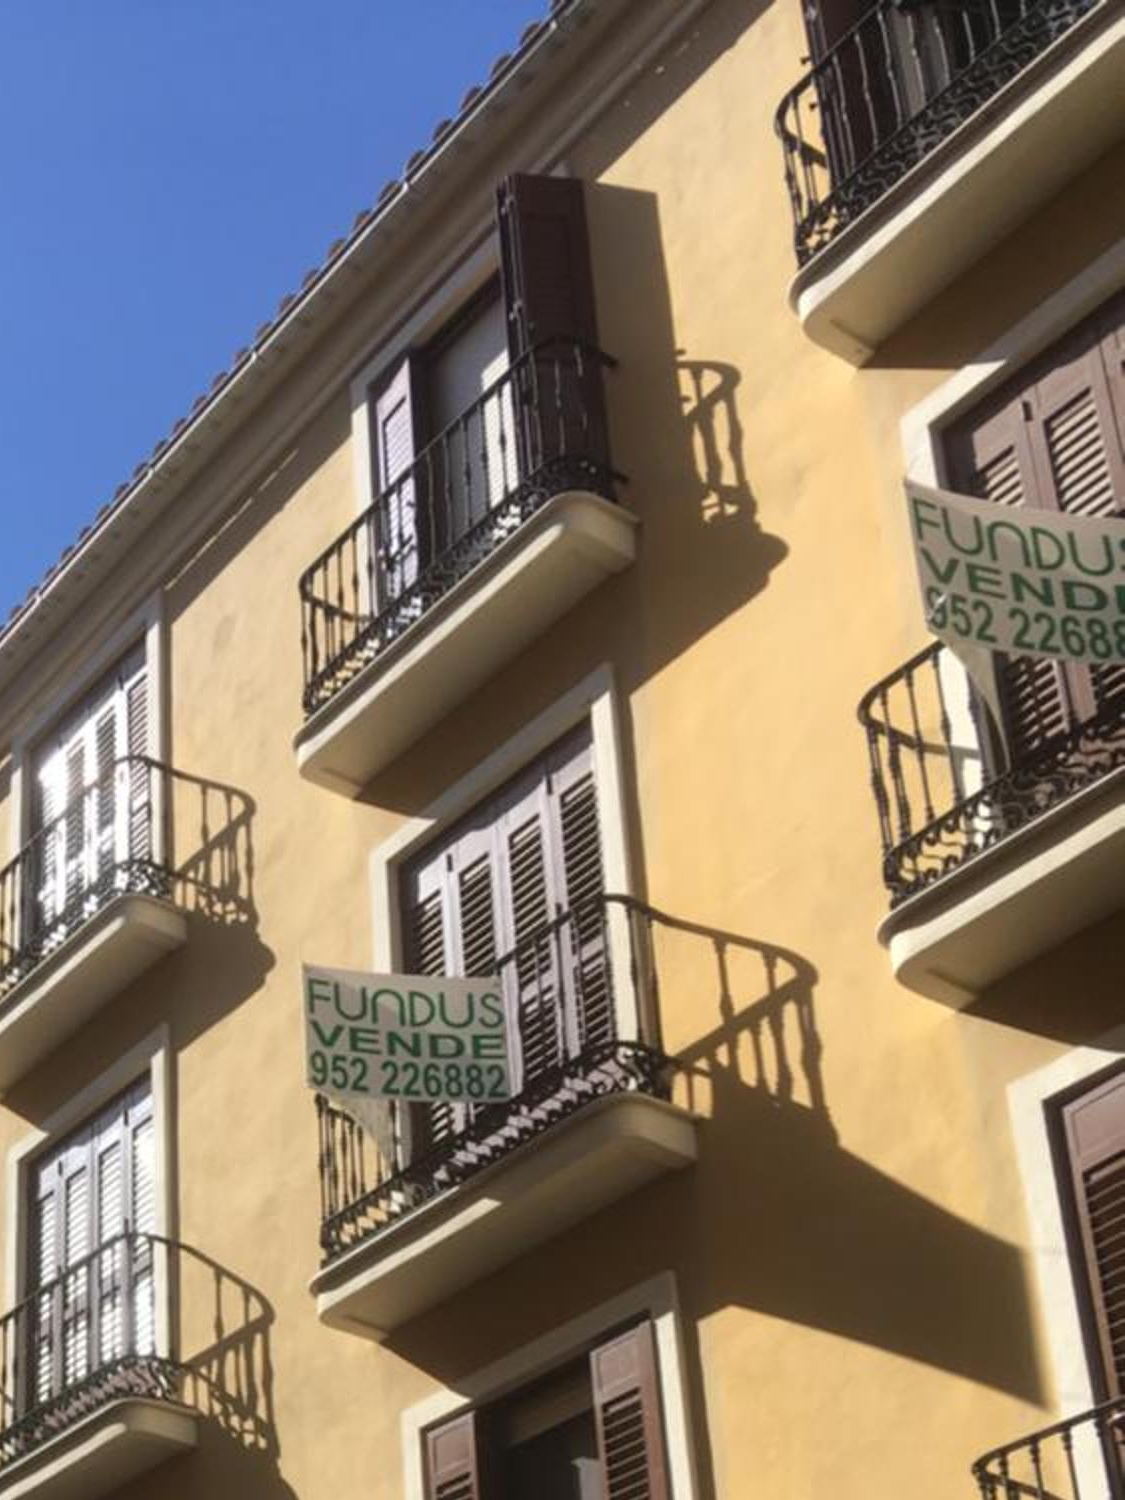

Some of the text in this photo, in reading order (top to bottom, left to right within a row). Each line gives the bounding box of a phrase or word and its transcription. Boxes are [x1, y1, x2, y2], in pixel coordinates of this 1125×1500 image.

[912, 498, 1125, 576] FUNDU
[926, 585, 998, 644] 952
[307, 977, 506, 1029] FUNDUS
[310, 1019, 508, 1060] VENDE
[309, 1050, 509, 1099] 952 226882
